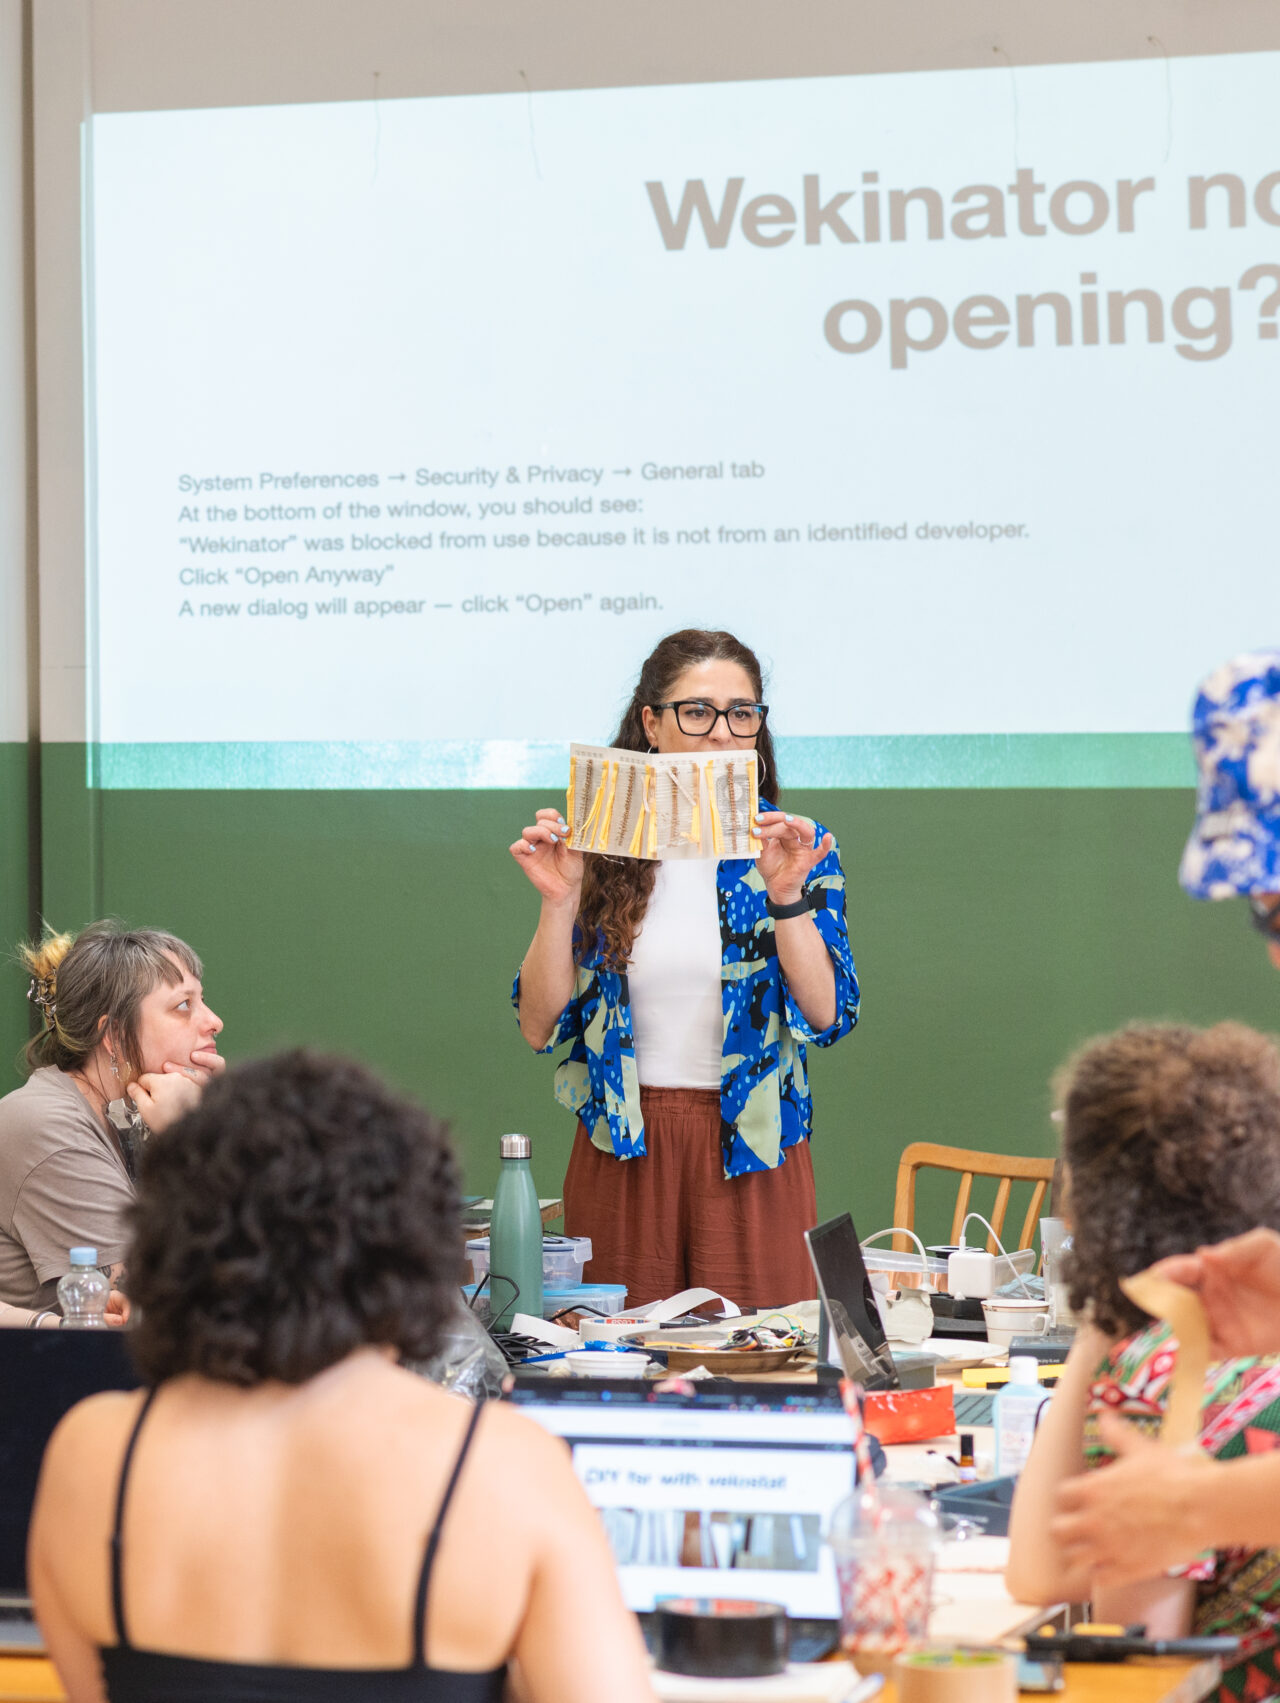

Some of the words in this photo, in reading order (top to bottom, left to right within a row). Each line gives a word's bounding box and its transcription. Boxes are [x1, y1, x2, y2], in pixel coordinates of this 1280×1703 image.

[644, 167, 1156, 252] Wekinator
[177, 473, 253, 496] System
[258, 471, 380, 490] Preferences
[415, 466, 500, 489] Security
[505, 465, 521, 485] &
[527, 464, 604, 487] Privacy
[640, 460, 724, 482] General
[729, 459, 766, 479] tab
[177, 505, 200, 523] At
[205, 504, 238, 523] the
[243, 504, 317, 522] bottom
[321, 501, 343, 520] of
[347, 501, 382, 520] the
[386, 499, 472, 520] window,
[477, 501, 517, 521] you
[522, 495, 594, 516] should
[599, 498, 643, 514] see:
[303, 536, 346, 552] was
[350, 531, 433, 552] blocked
[438, 530, 487, 550] from
[492, 533, 531, 549] use
[536, 528, 627, 548] because
[632, 526, 646, 546] it
[652, 526, 670, 545] is
[676, 526, 711, 545] not
[717, 524, 767, 544] from
[773, 528, 801, 544] an
[807, 521, 908, 542] identified
[914, 520, 1030, 544] developer.
[178, 567, 230, 587] Click
[177, 599, 195, 618] A
[199, 602, 242, 618] new
[246, 597, 309, 621] dialog
[314, 596, 348, 616] will
[353, 599, 427, 619] appear
[460, 594, 510, 614] click
[599, 592, 664, 616] again.
